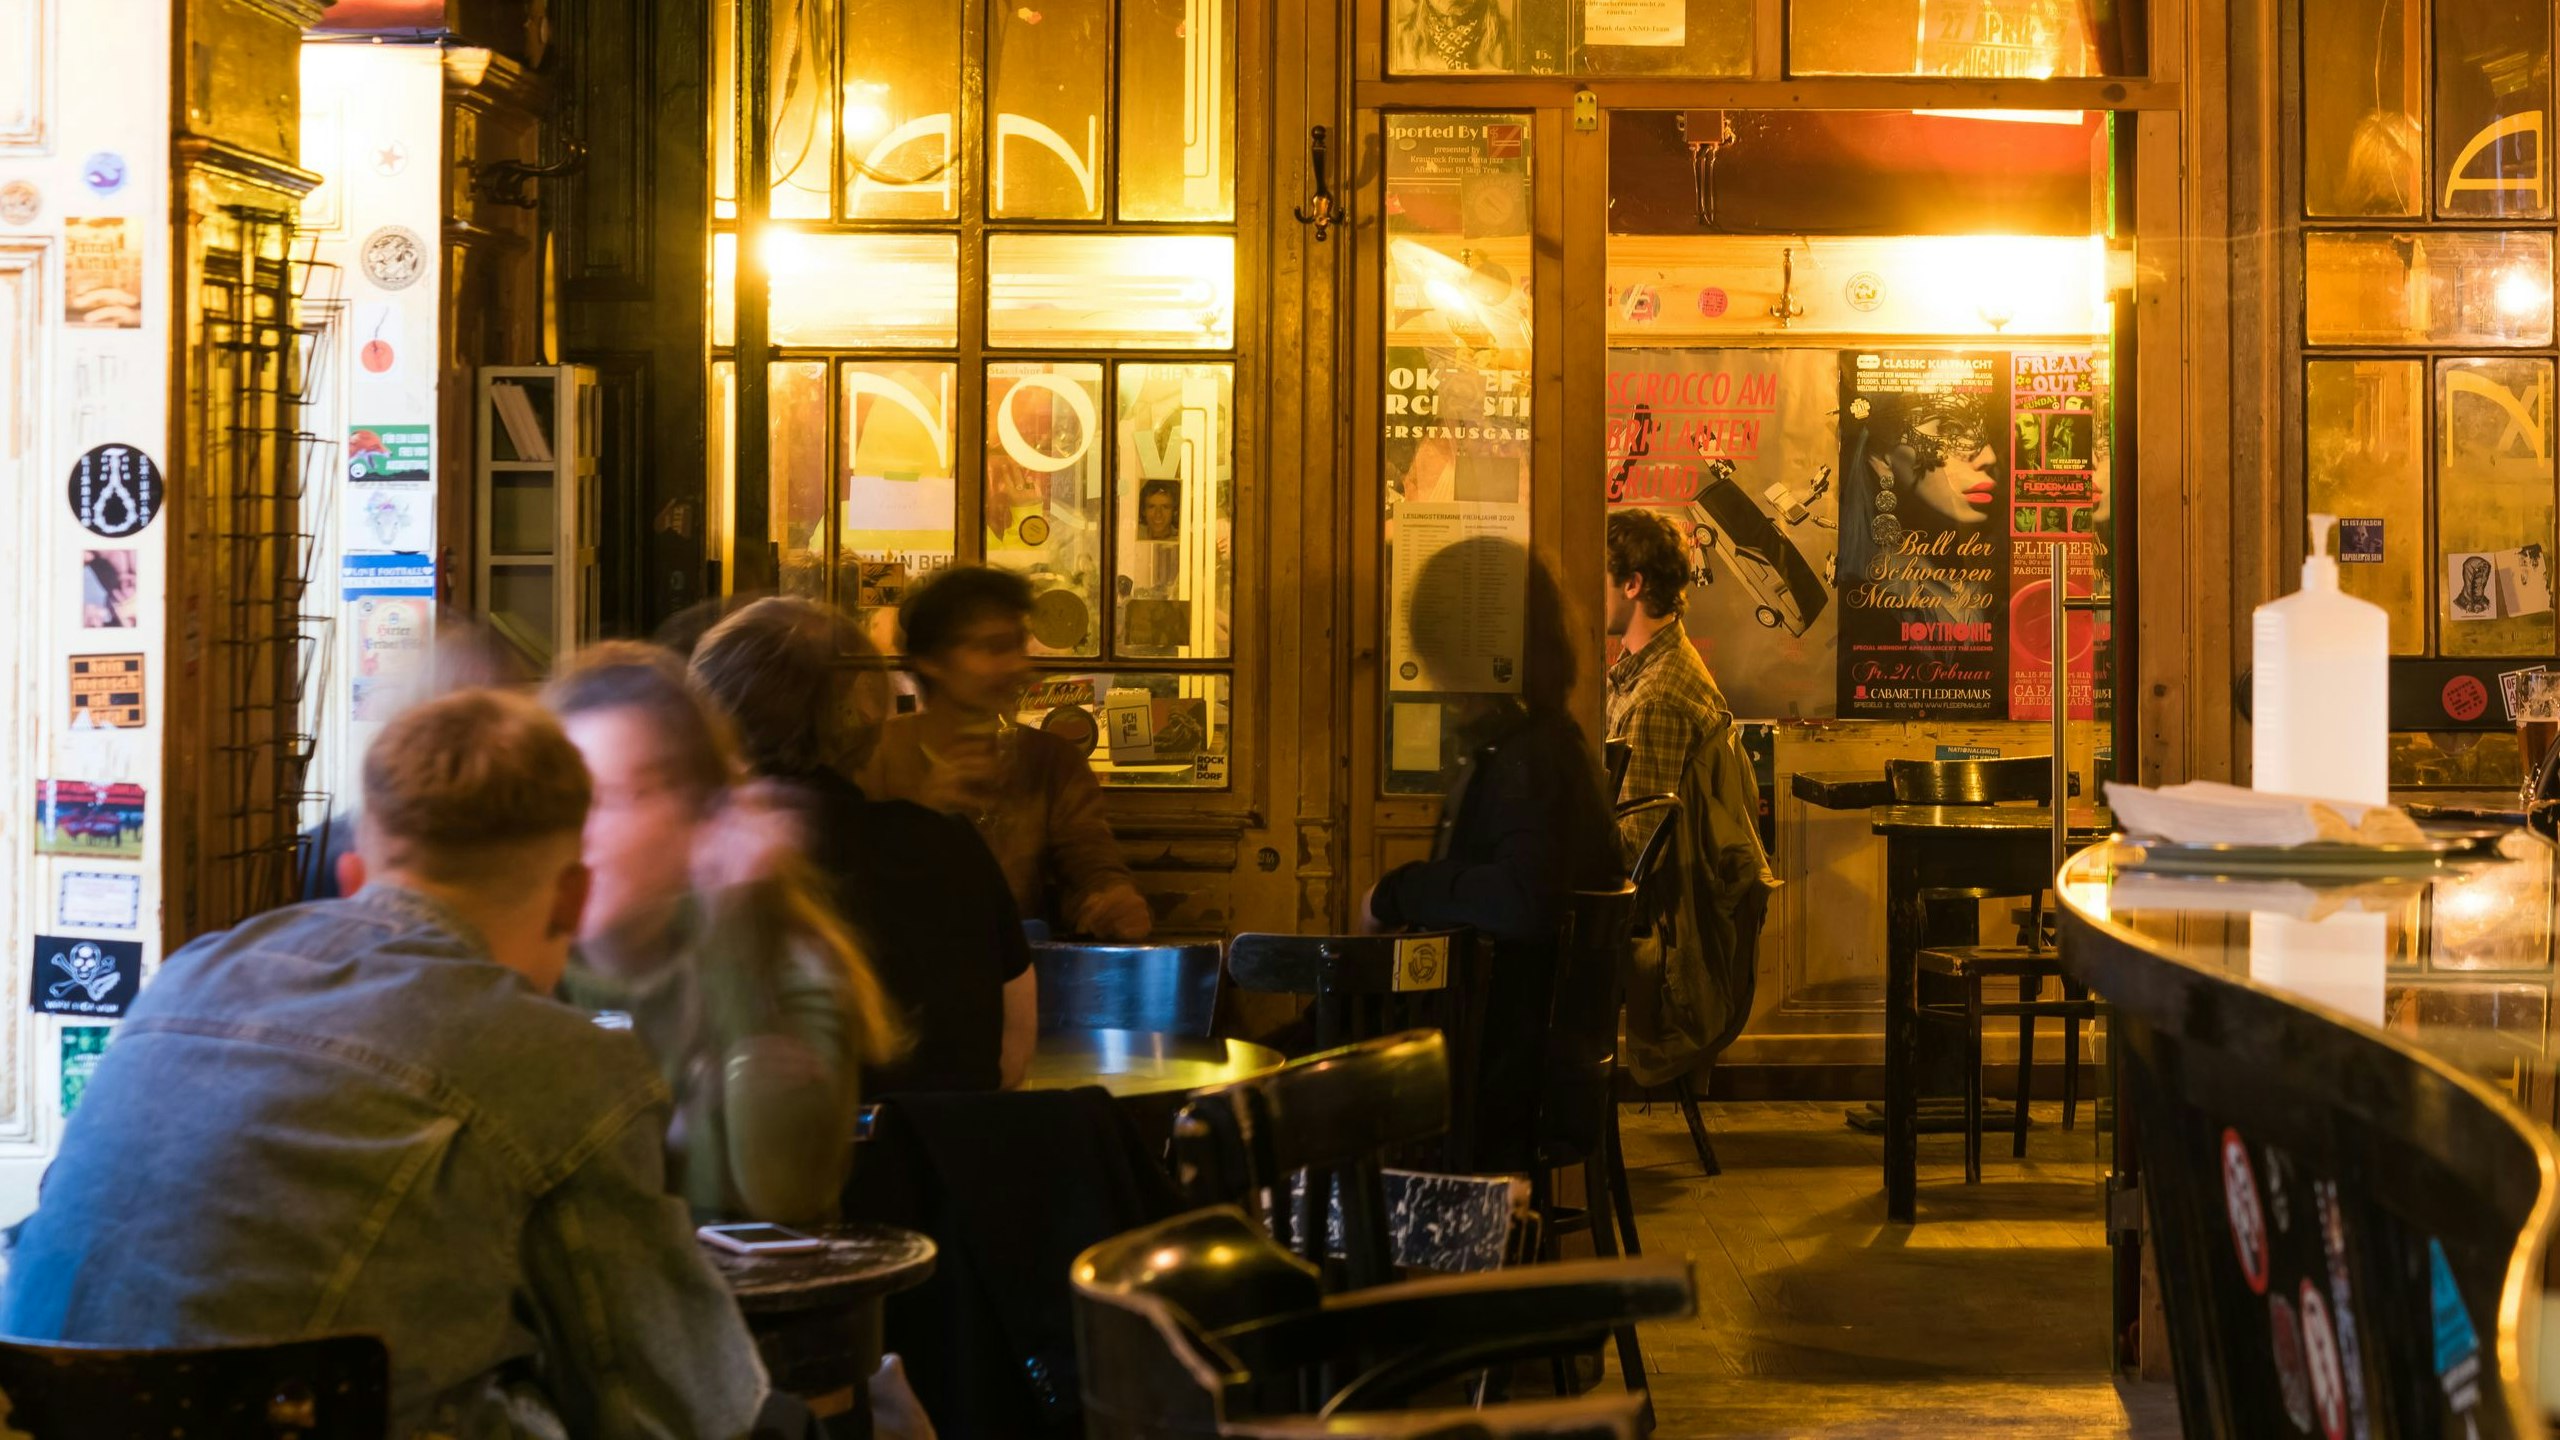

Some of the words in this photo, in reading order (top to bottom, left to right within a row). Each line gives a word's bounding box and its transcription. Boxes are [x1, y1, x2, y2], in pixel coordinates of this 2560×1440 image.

[1458, 125, 1478, 140] By
[1883, 359, 1926, 370] CLASSIC
[1928, 359, 1994, 370] KULTNACHT
[2016, 353, 2092, 374] FREAK
[1607, 371, 1732, 406] SCIROCCO
[1736, 372, 1777, 406] AM
[2032, 374, 2078, 393] OUT
[2024, 395, 2058, 410] SUNDAY
[1607, 419, 1760, 452] BRILLANTEN
[1607, 466, 1699, 499] GRUND
[2023, 482, 2084, 491] FLEDERMAUS
[1403, 513, 1460, 521] LESUNGSTERMINE
[1463, 513, 1497, 521] FRÜHJAHR
[1893, 530, 1956, 556] Ball
[1957, 531, 1995, 556] der
[1866, 552, 1995, 593] Schwarzen
[1846, 583, 1942, 609] Masken
[1951, 592, 1993, 609] 2020
[1901, 621, 1993, 642] BOYTRONIC
[1917, 661, 1992, 683] Februar
[1871, 688, 1919, 700] CABARET
[1922, 688, 1991, 700] FLEDERMAUS
[1197, 756, 1224, 764] ROCK
[1947, 746, 1999, 755] NATIONALISMUS
[1196, 772, 1223, 780] DORF
